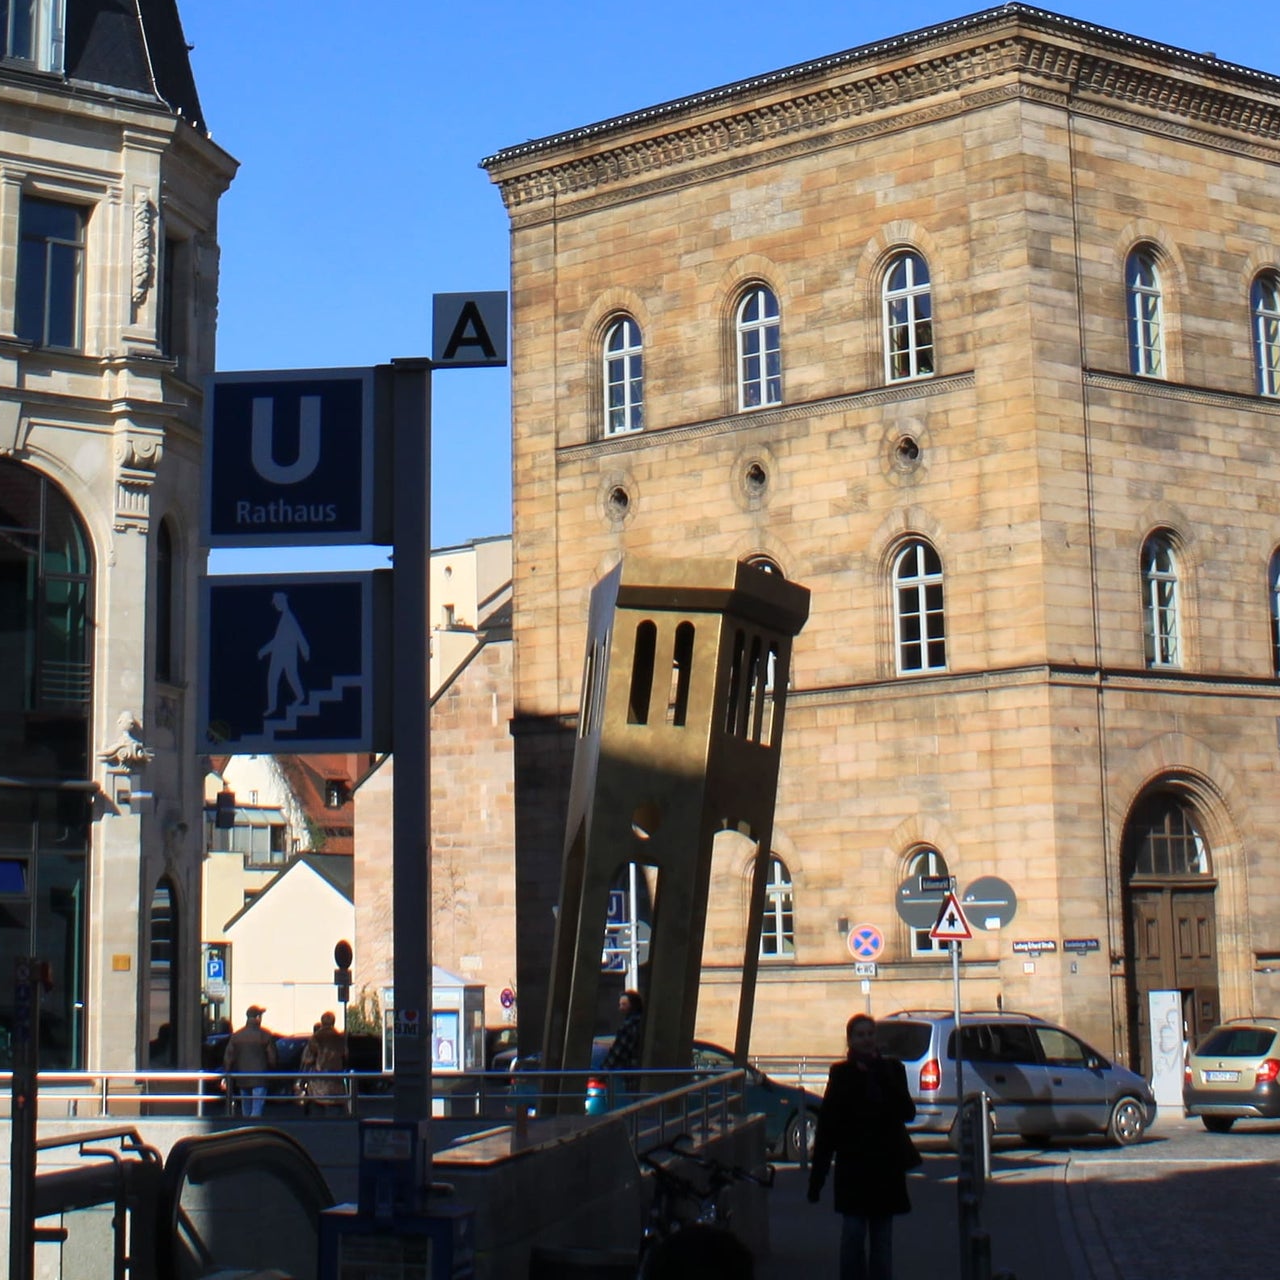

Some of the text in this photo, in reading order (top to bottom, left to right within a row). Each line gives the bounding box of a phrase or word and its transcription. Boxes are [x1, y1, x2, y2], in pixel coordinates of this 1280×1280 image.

[443, 301, 497, 360] A
[251, 395, 322, 485] U
[236, 499, 337, 524] Rathaus
[210, 963, 219, 976] P
